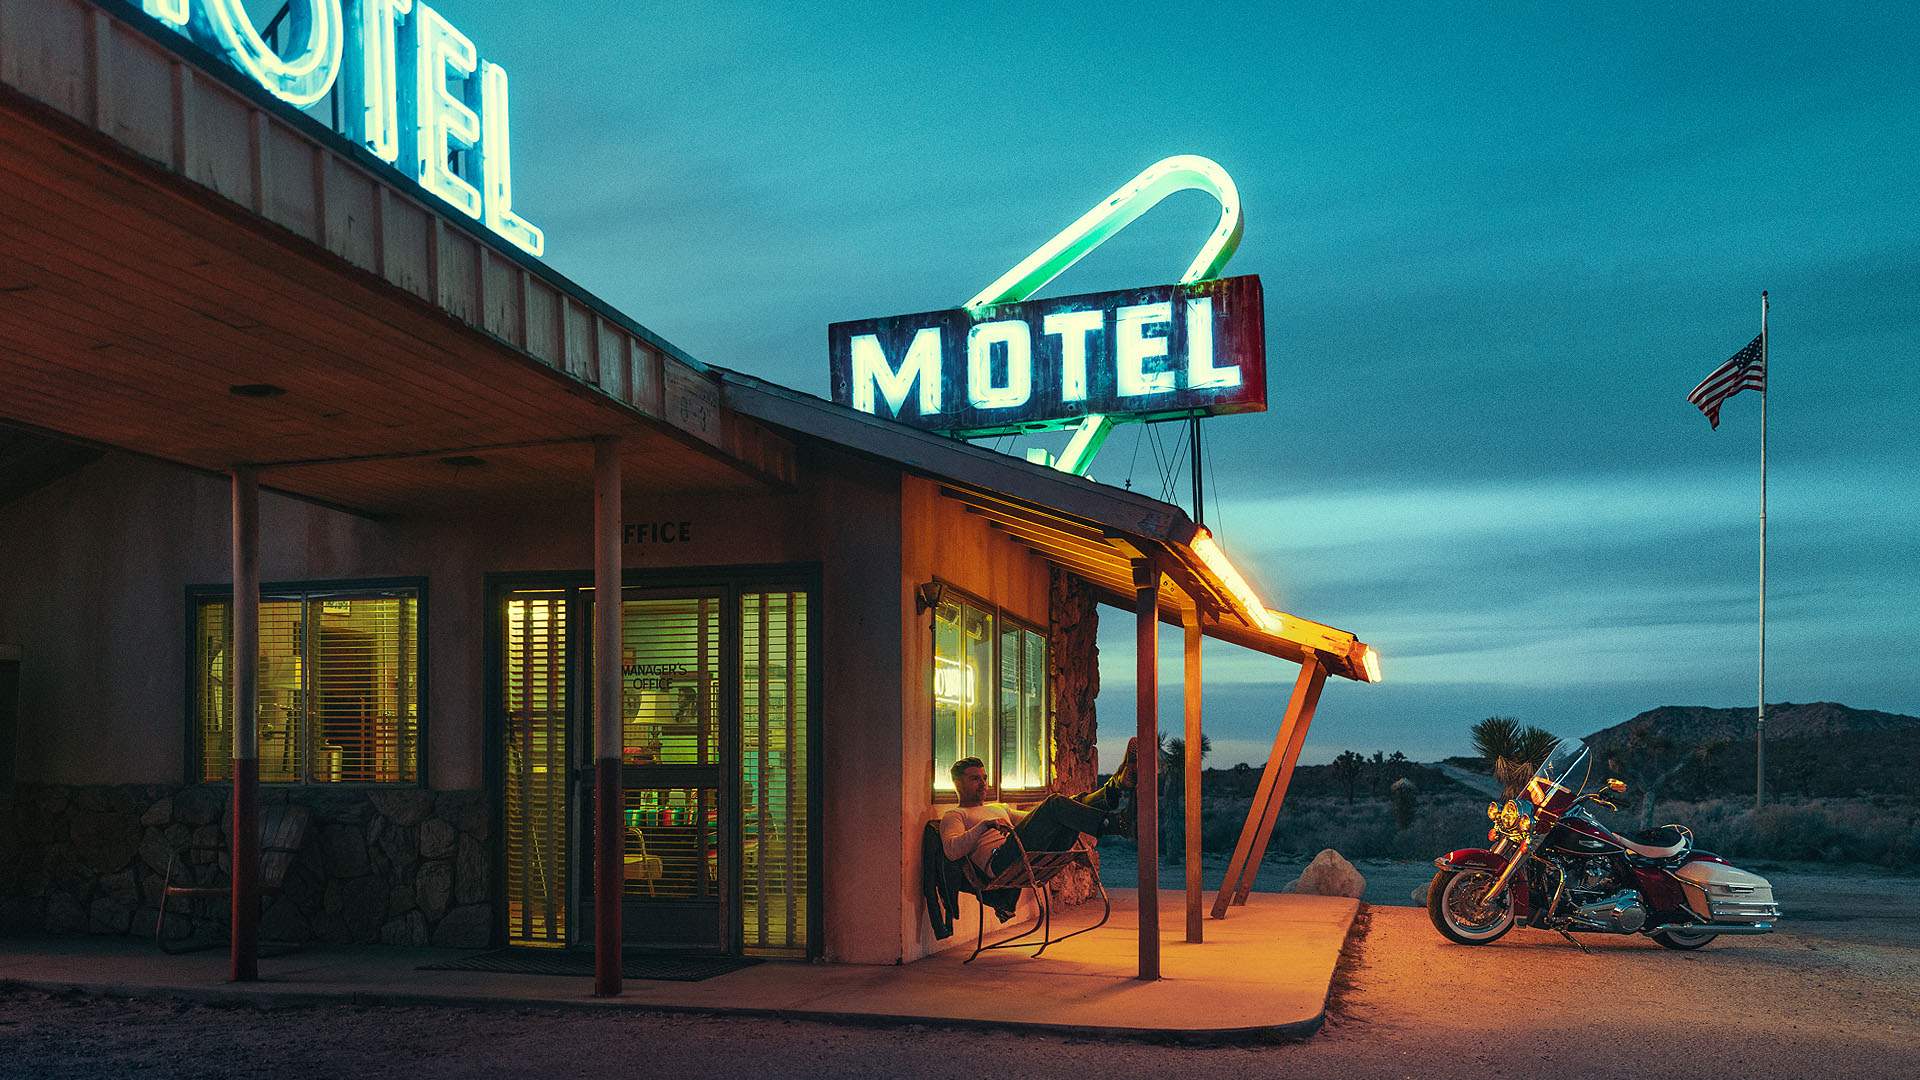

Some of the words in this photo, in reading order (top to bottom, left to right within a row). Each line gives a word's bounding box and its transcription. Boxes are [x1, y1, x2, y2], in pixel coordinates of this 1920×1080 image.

[142, 0, 544, 257] TEL
[851, 297, 1242, 418] MOTEL
[624, 522, 691, 544] FFICE
[621, 663, 688, 677] MANAGER'S
[633, 678, 673, 690] OFFICE
